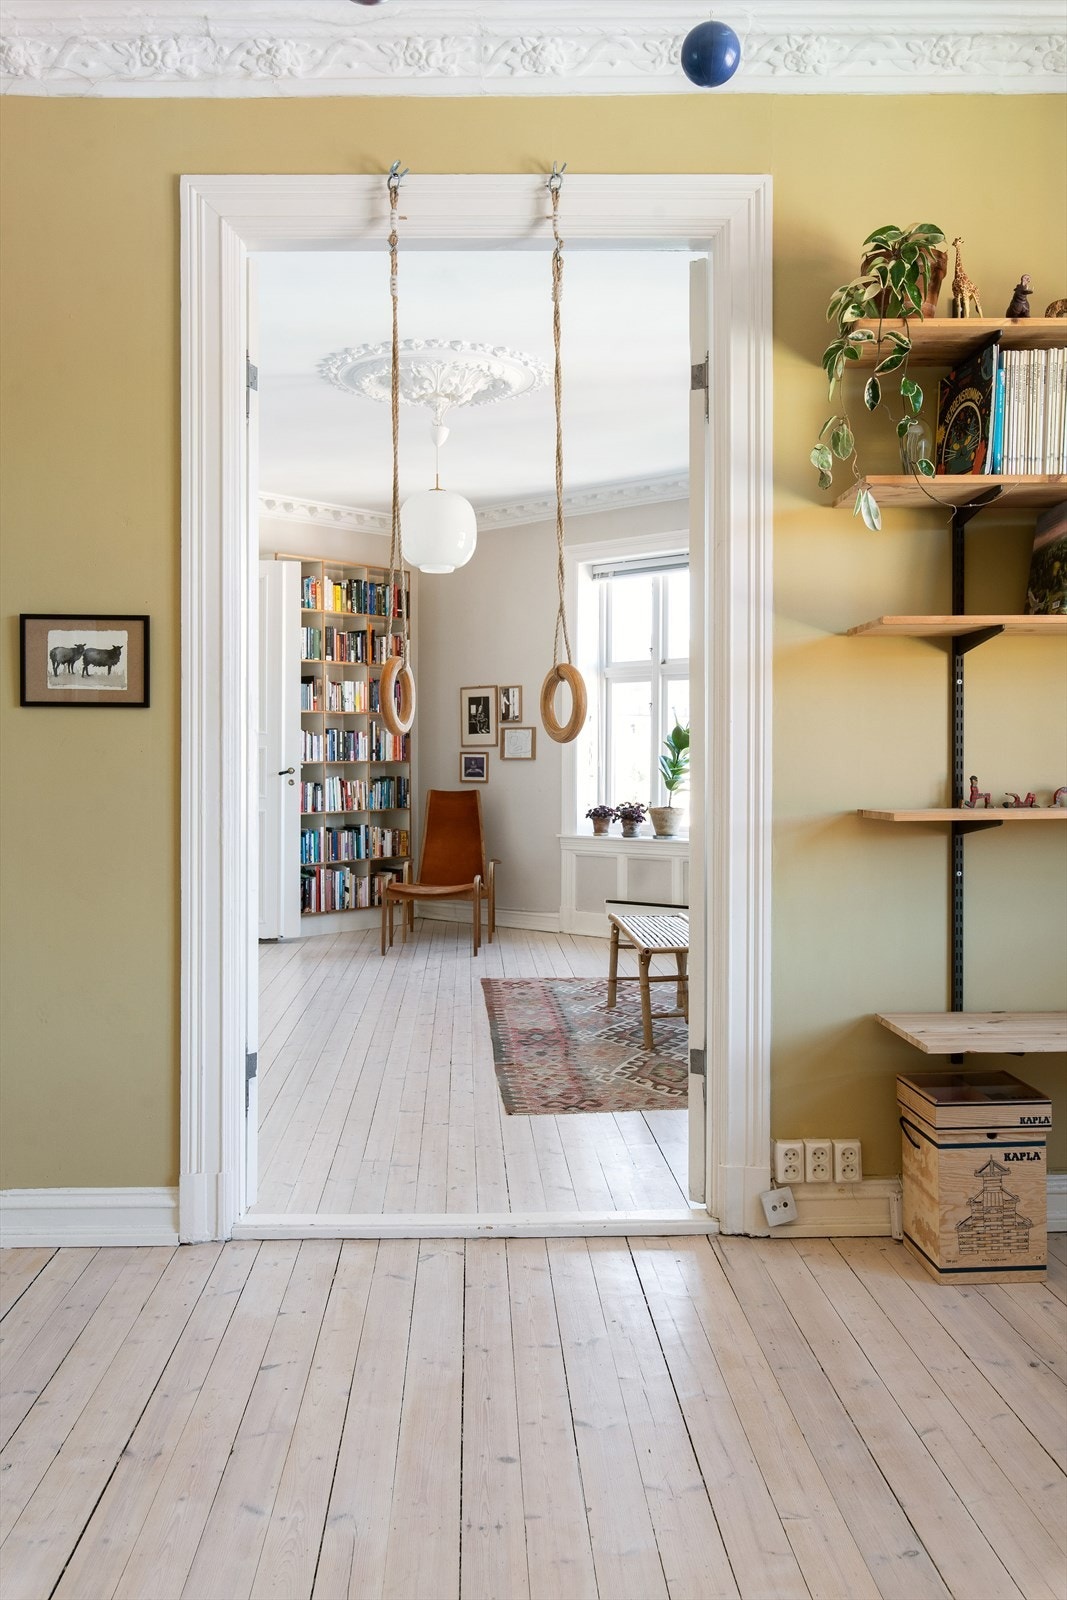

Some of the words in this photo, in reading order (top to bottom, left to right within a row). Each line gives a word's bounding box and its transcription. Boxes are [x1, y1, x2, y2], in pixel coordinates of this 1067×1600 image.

[945, 387, 983, 423] VERDENSET
[1020, 1116, 1050, 1124] KAPLA
[1004, 1152, 1041, 1161] KAPLA
